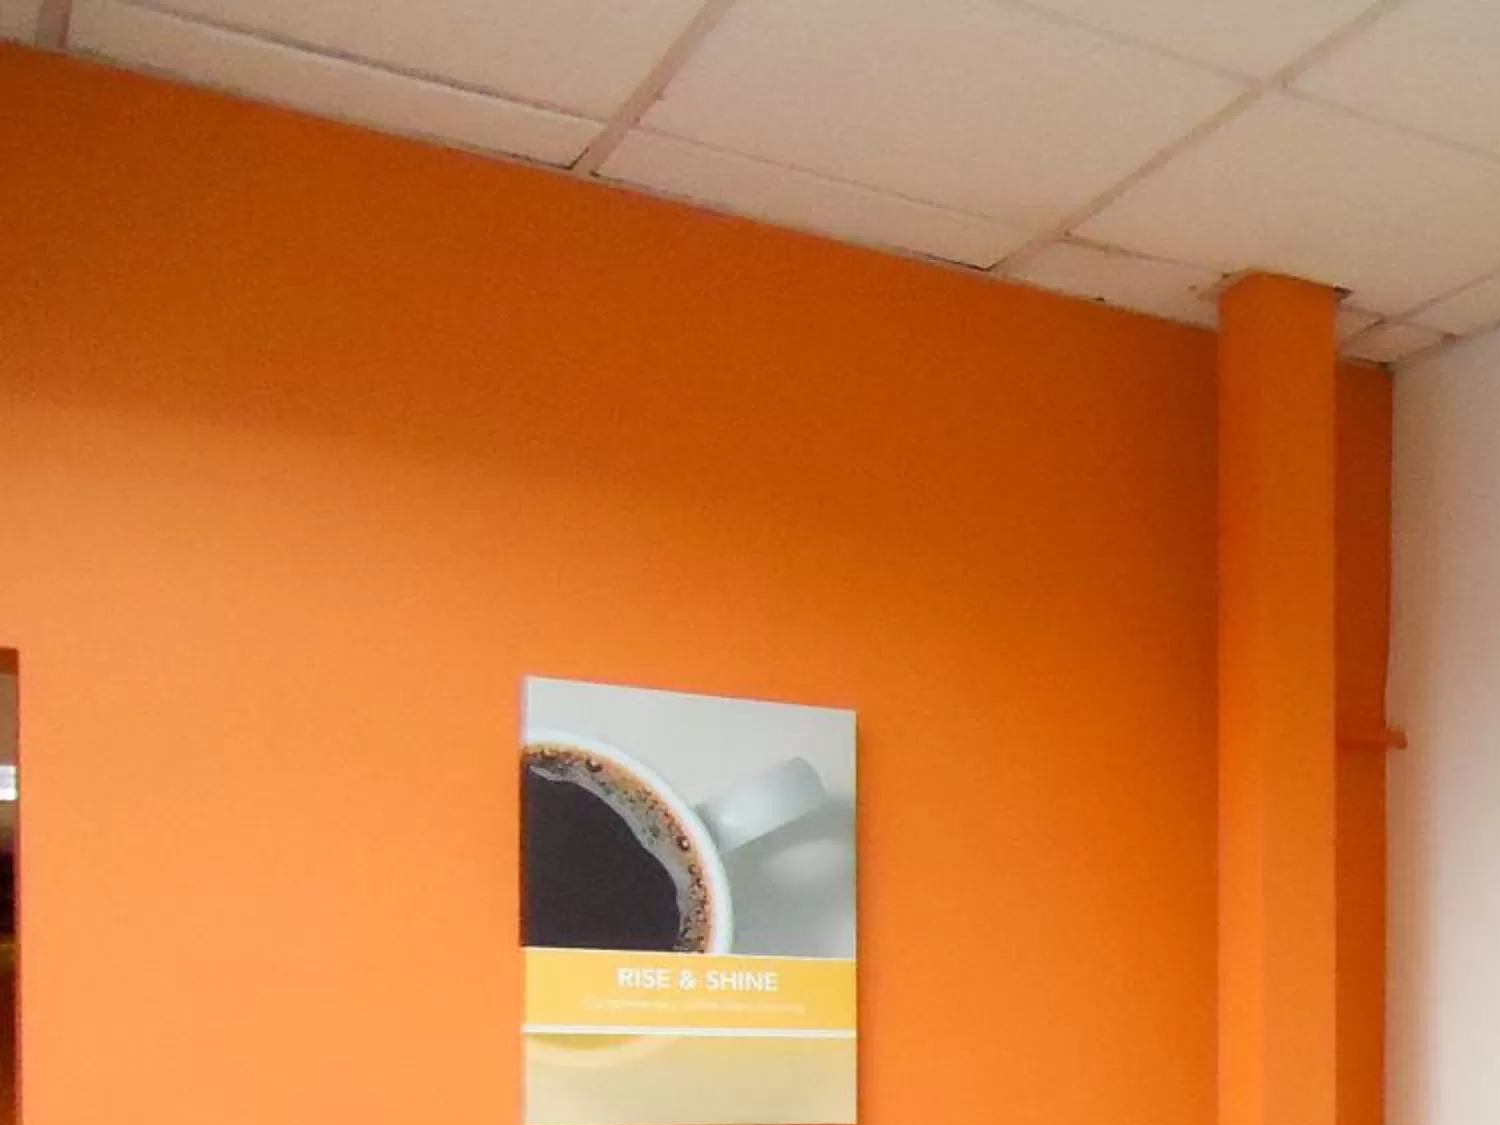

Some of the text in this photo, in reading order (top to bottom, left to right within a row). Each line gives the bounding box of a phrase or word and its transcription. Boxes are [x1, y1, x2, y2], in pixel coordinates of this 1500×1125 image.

[617, 967, 779, 992] RISE & SHINE
